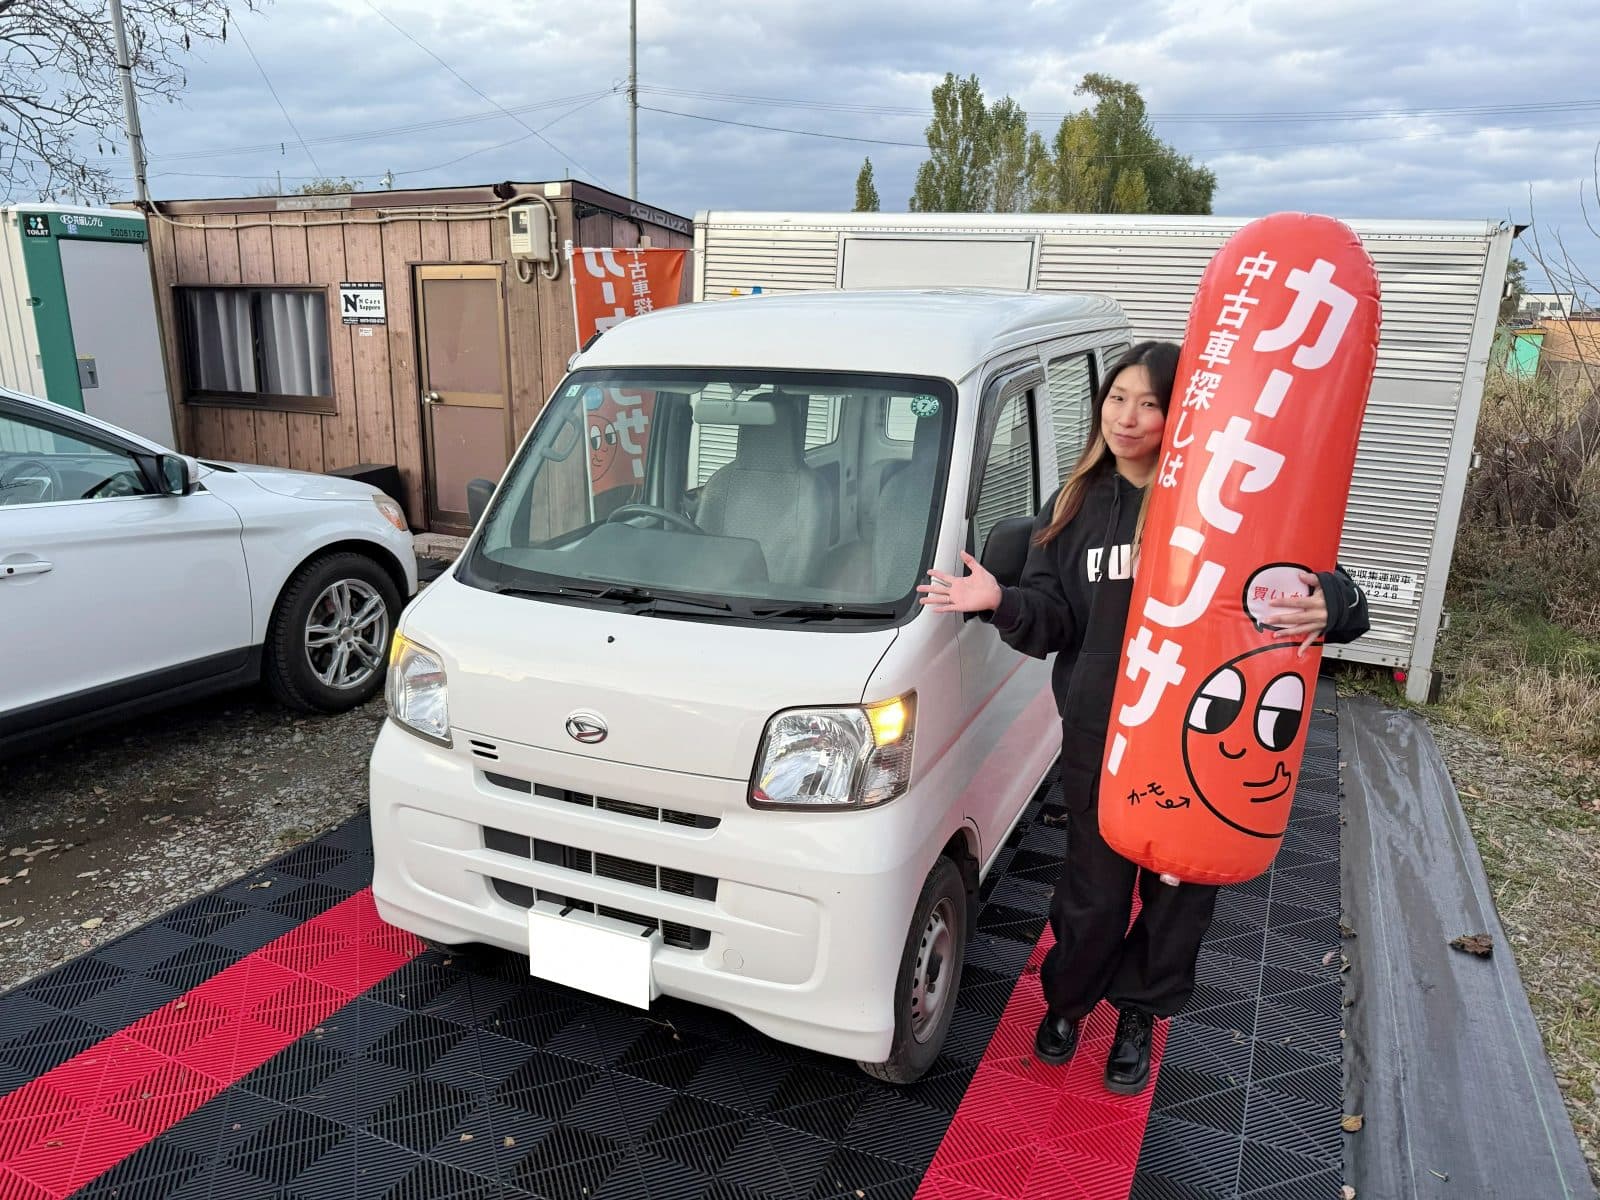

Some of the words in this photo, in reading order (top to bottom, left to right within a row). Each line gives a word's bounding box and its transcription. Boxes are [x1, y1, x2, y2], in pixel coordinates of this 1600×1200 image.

[343, 294, 361, 313] N
[1158, 251, 1278, 488] 中古車探しは
[1107, 258, 1358, 776] カーセンサー
[1087, 544, 1139, 583] PU
[1126, 781, 1166, 806] カーモ
